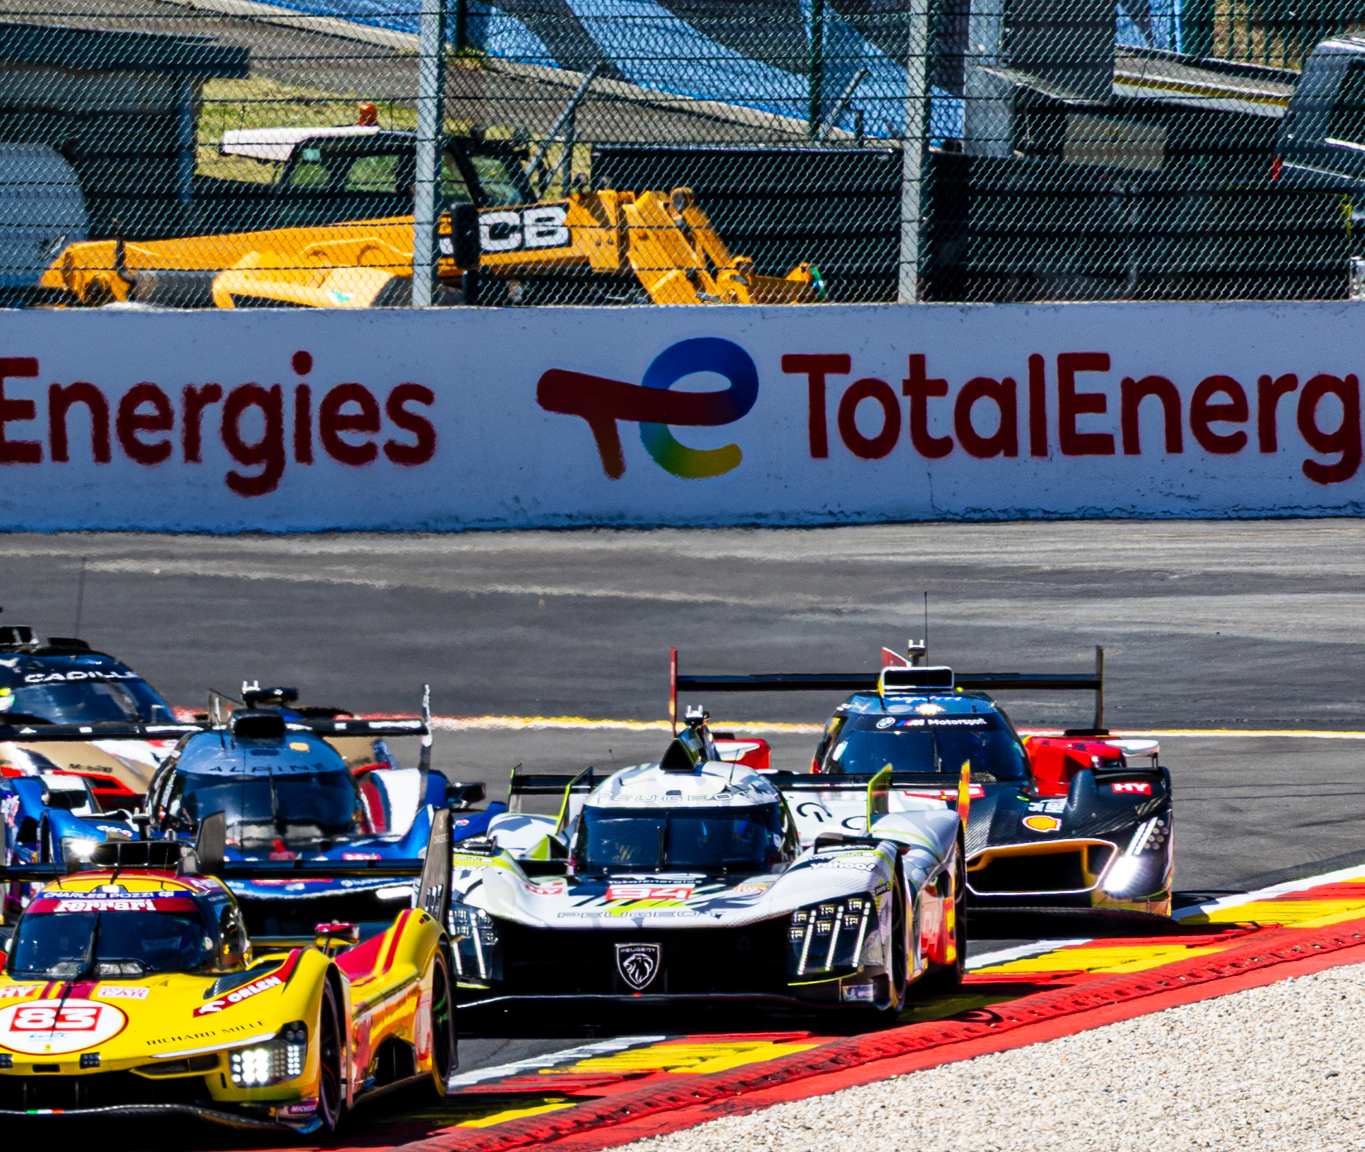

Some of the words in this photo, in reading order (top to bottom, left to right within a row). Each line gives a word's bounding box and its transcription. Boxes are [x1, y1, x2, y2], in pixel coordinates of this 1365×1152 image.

[781, 352, 1362, 485] TotalEnerg
[927, 717, 988, 727] Motorsport
[208, 762, 327, 774] ALPINE
[1113, 782, 1149, 792] HY
[810, 861, 878, 872] yahoo!
[610, 887, 689, 900] 94
[53, 898, 157, 913] Ferrari
[556, 911, 726, 919] PEUGEOT
[227, 975, 283, 1003] ORLEN
[14, 1008, 99, 1029] 83
[145, 1030, 216, 1046] RICHARD
[221, 1019, 268, 1034] MILLE
